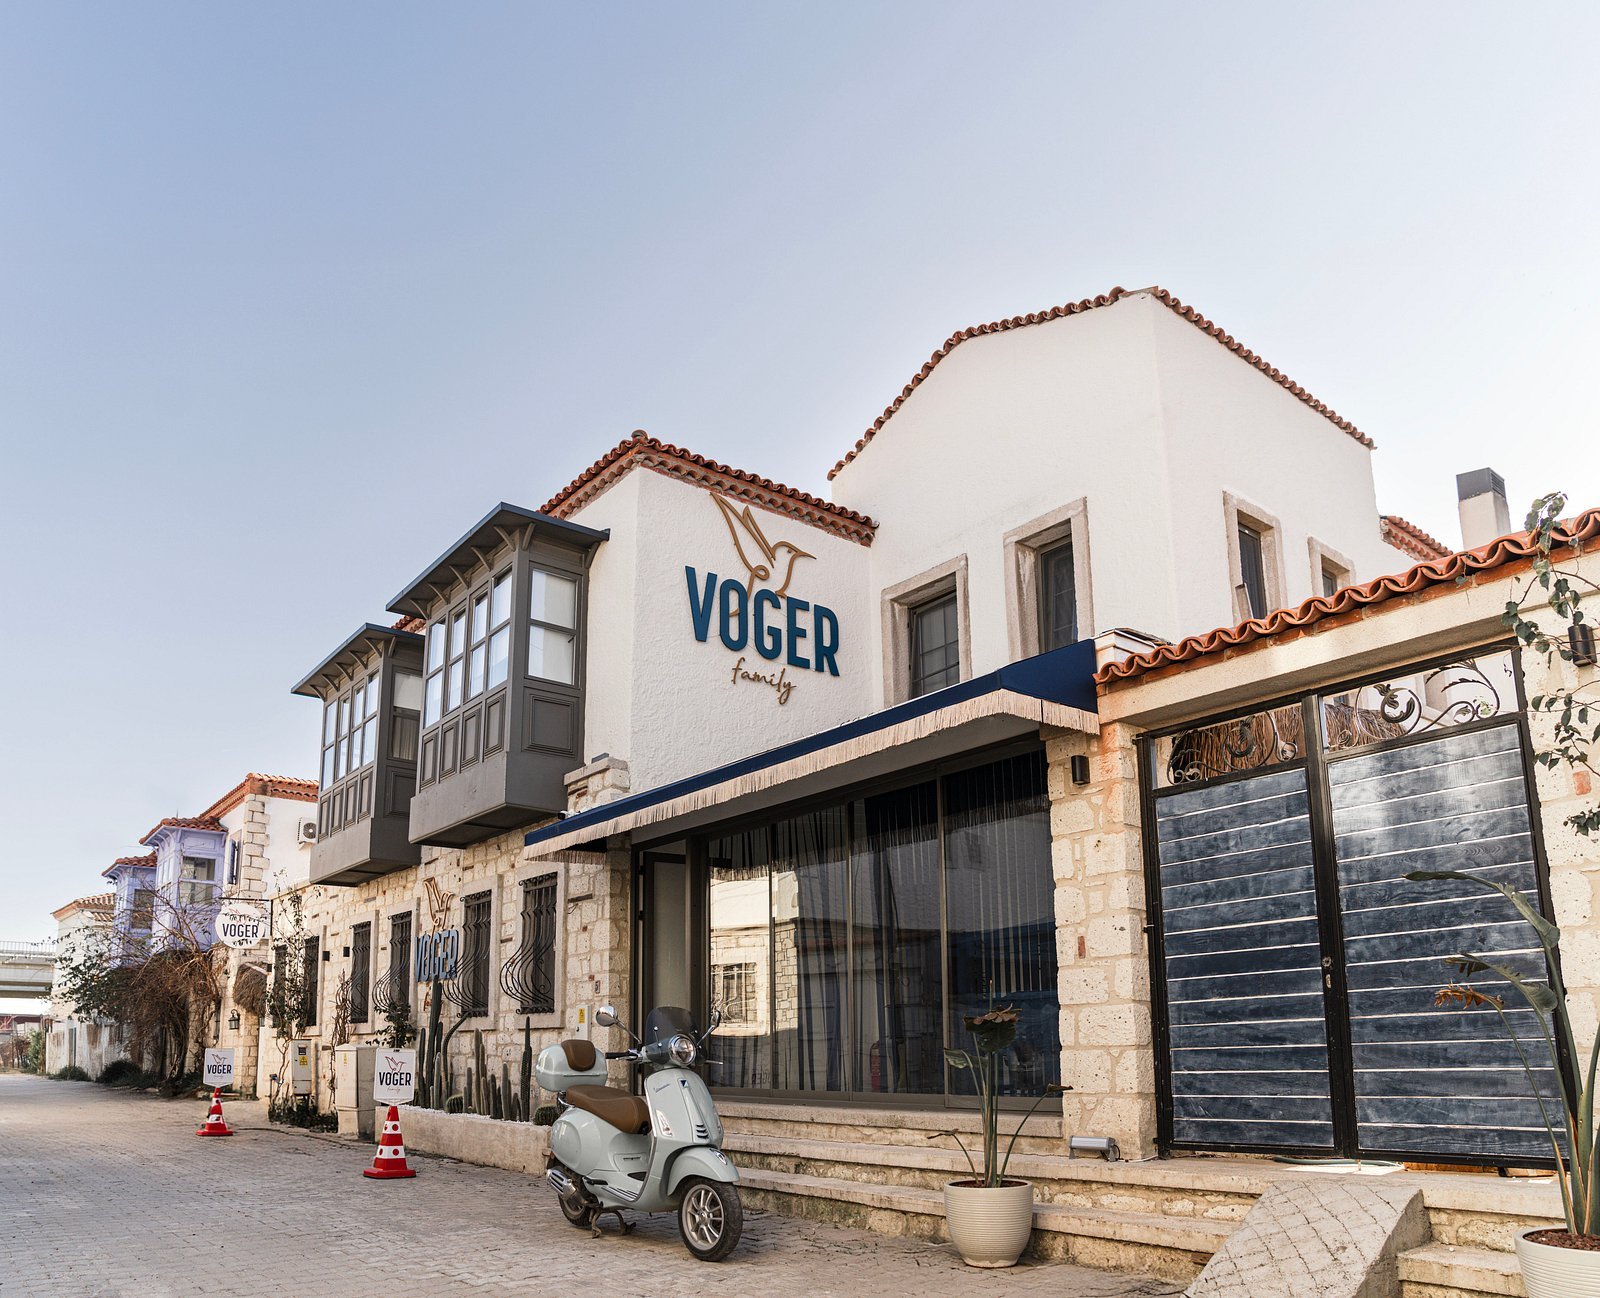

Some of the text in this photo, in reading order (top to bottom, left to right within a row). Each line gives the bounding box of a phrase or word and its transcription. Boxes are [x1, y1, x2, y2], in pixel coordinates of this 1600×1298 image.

[685, 565, 840, 677] VOGER
[731, 656, 797, 706] family
[222, 923, 259, 938] VOGER
[414, 929, 459, 982] VOGER
[207, 1064, 232, 1075] VOGER
[378, 1071, 412, 1086] VOGER
